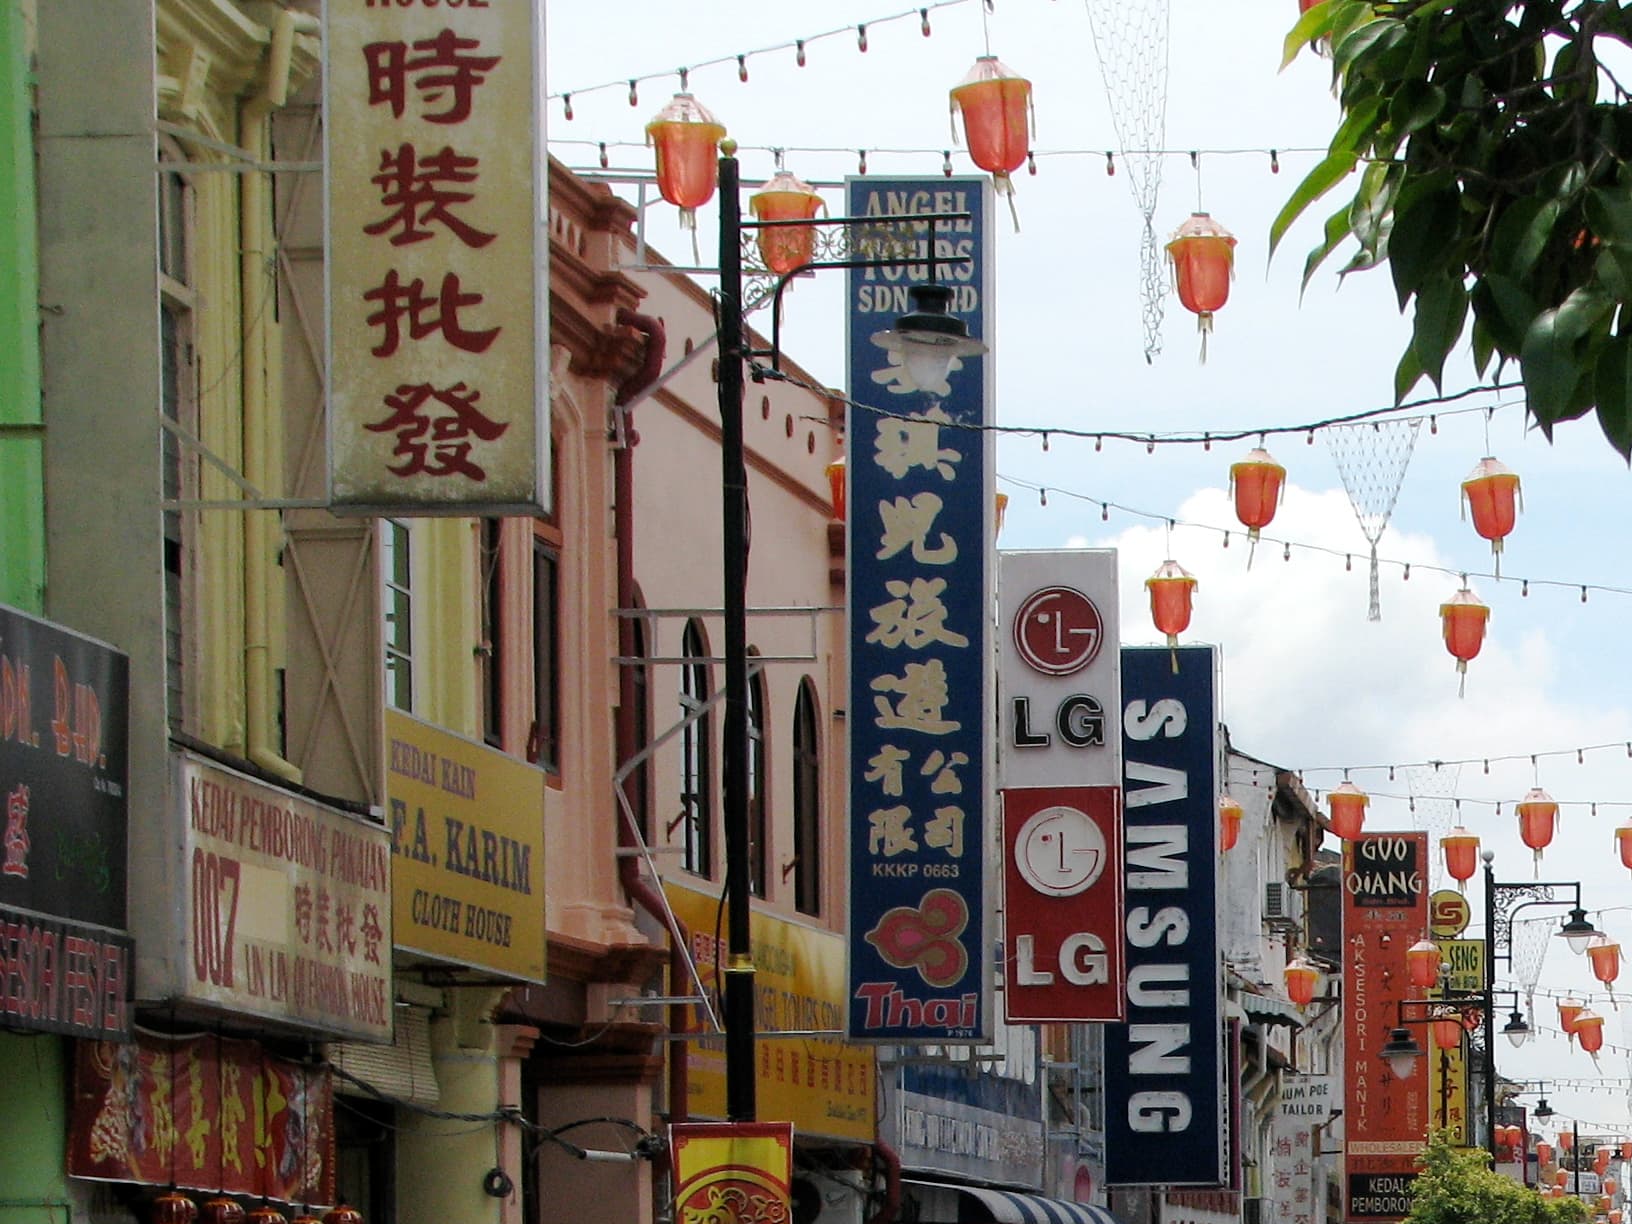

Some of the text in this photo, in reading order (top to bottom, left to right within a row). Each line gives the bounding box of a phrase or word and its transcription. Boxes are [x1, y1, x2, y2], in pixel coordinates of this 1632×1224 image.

[864, 190, 973, 234] ANGEL
[363, 28, 509, 481] 時裝批發
[862, 238, 974, 283] TOURS
[1013, 694, 1105, 749] LG
[391, 738, 476, 800] KEDAI KAIN
[192, 776, 386, 893] KEDAI PEMBORONG PAKAIAN
[444, 816, 532, 895] KARIM
[1362, 837, 1407, 861] GUO
[872, 863, 960, 878] KKKP 0663
[193, 847, 241, 988] 007
[411, 888, 513, 948] CLOTH HOUSE
[1124, 698, 1193, 1133] SAMSUNG
[1015, 932, 1108, 986] LG
[351, 972, 386, 1027] HOUSE
[855, 981, 977, 1030] Thai
[1355, 934, 1368, 1131] AKSESORI MANIK
[1282, 1104, 1323, 1116] TAILOR
[1369, 1178, 1404, 1192] KEDAI
